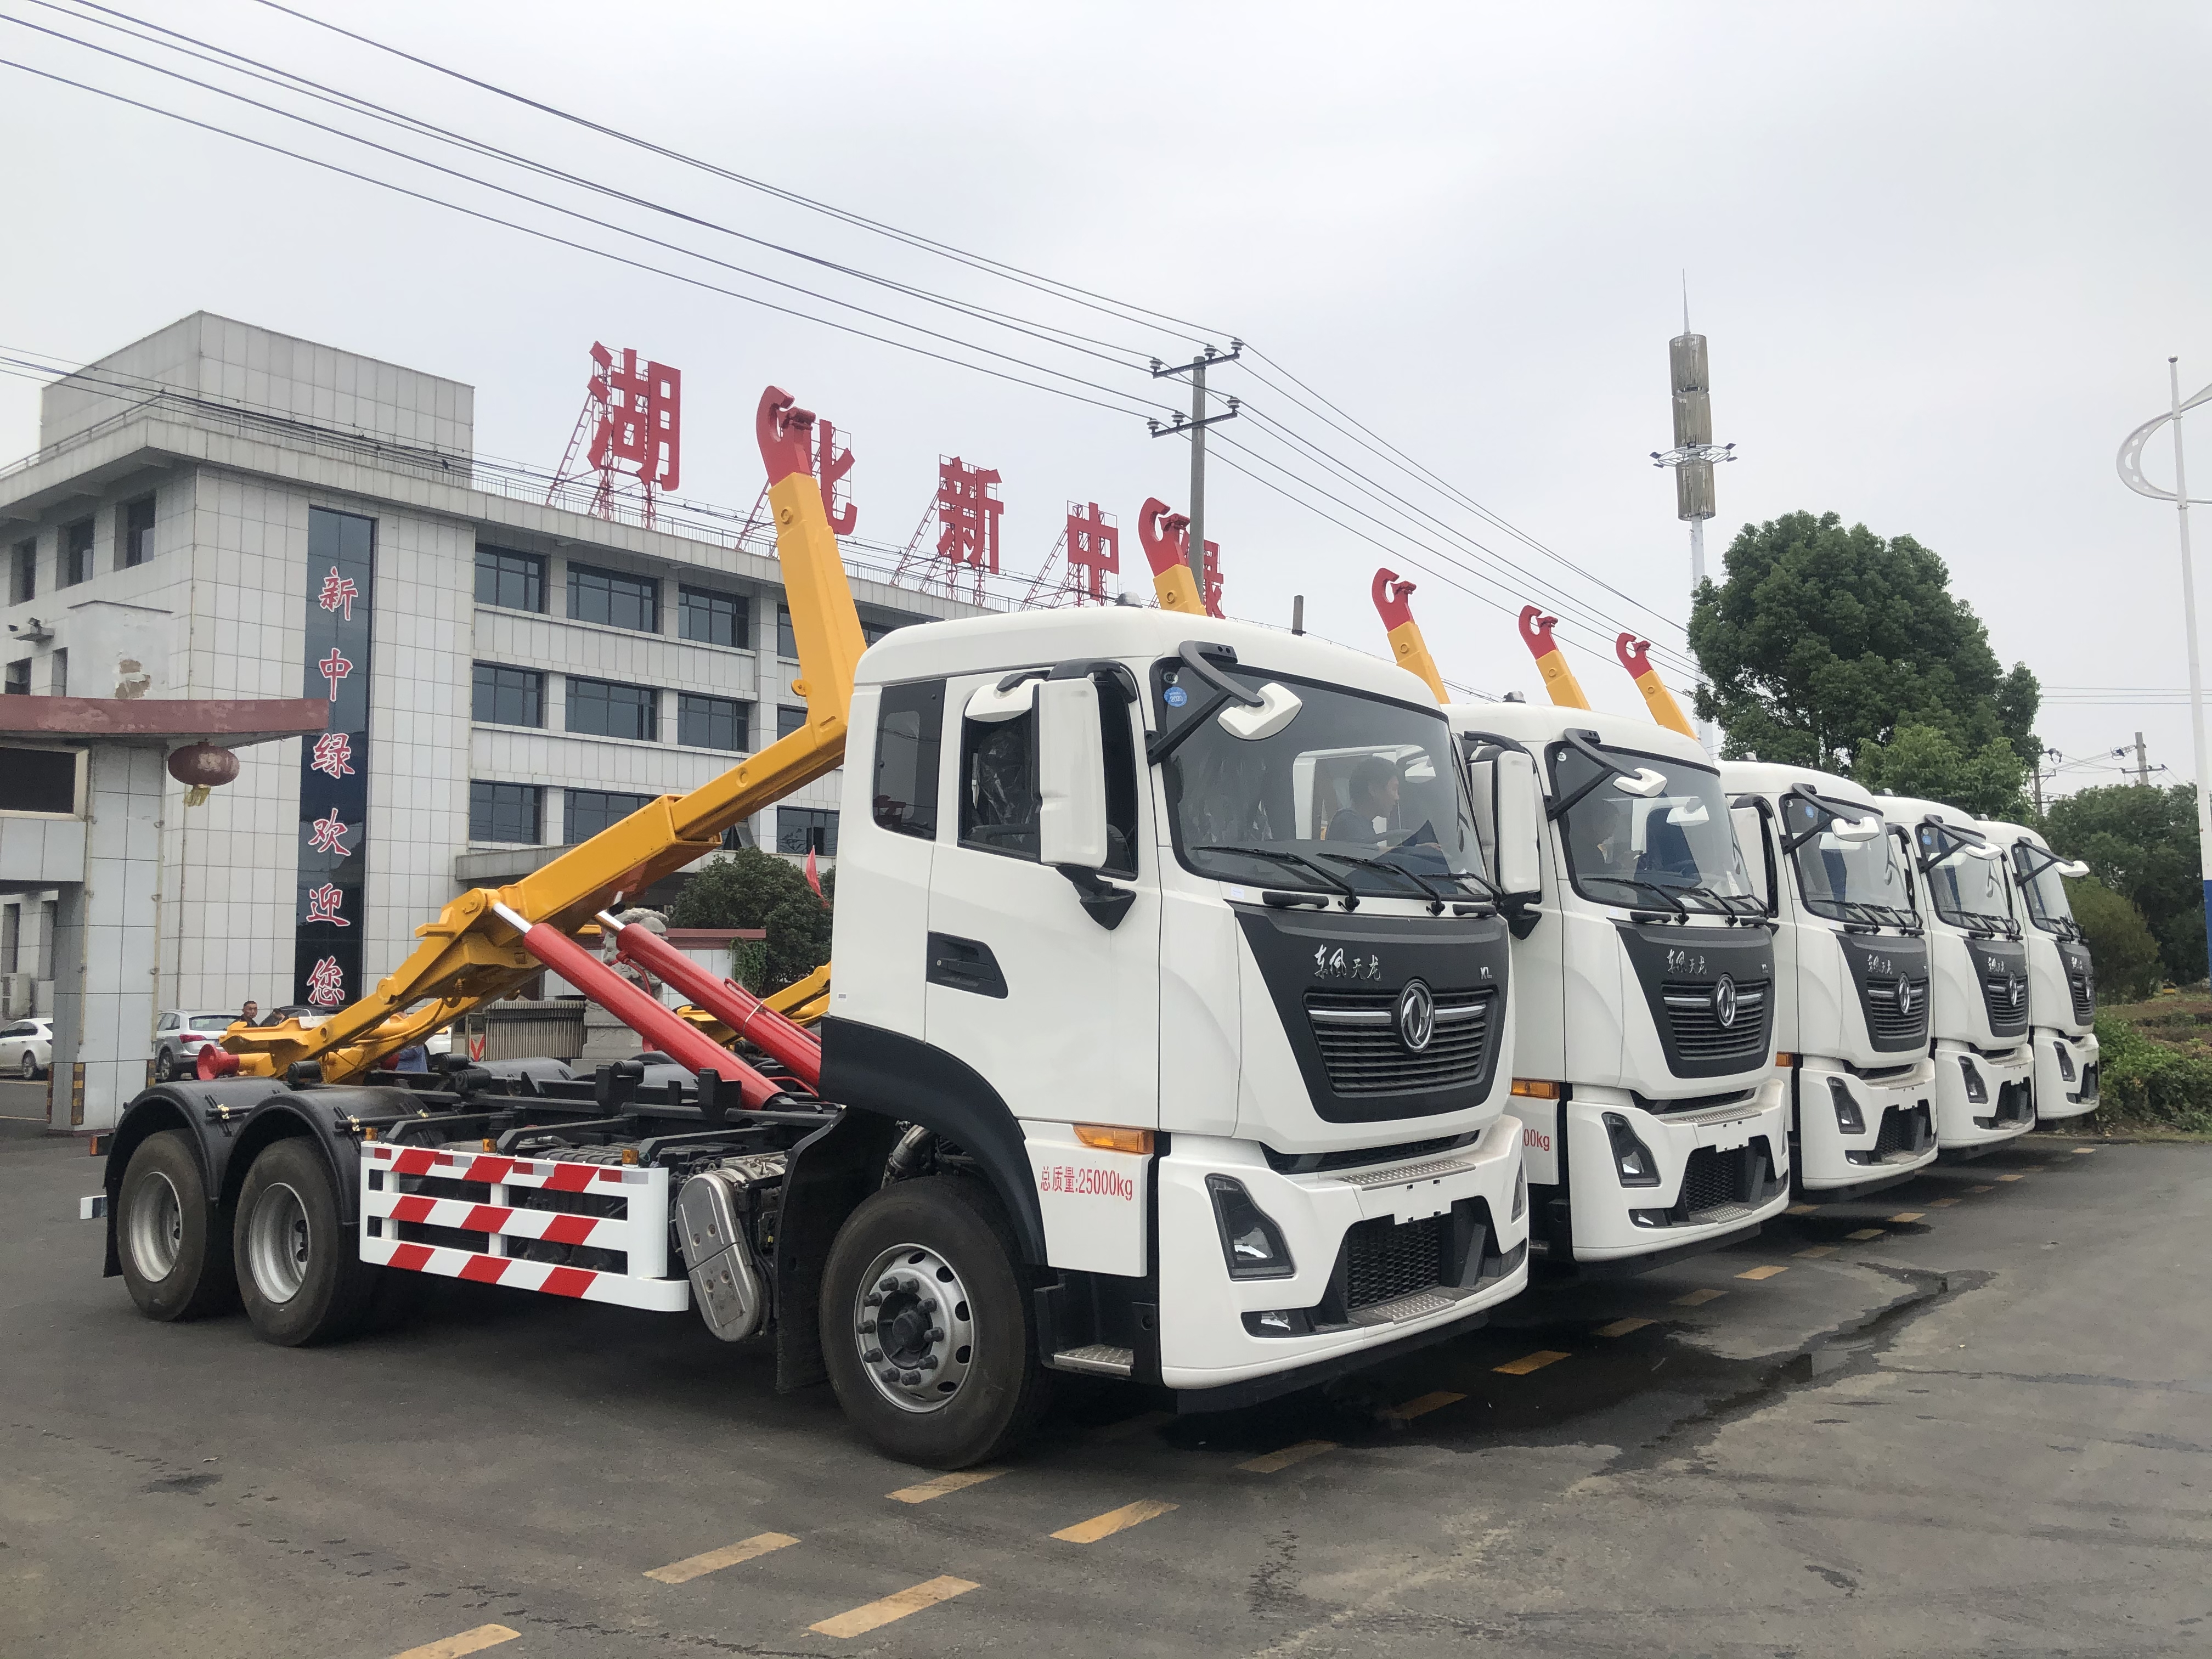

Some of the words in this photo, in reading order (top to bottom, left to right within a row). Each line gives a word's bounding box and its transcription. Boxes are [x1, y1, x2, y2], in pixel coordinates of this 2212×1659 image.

[306, 566, 358, 1006] 新中绿欢迎您
[1523, 1128, 1550, 1152] 00kg
[1040, 1166, 1133, 1201] 总质量:25000kg
